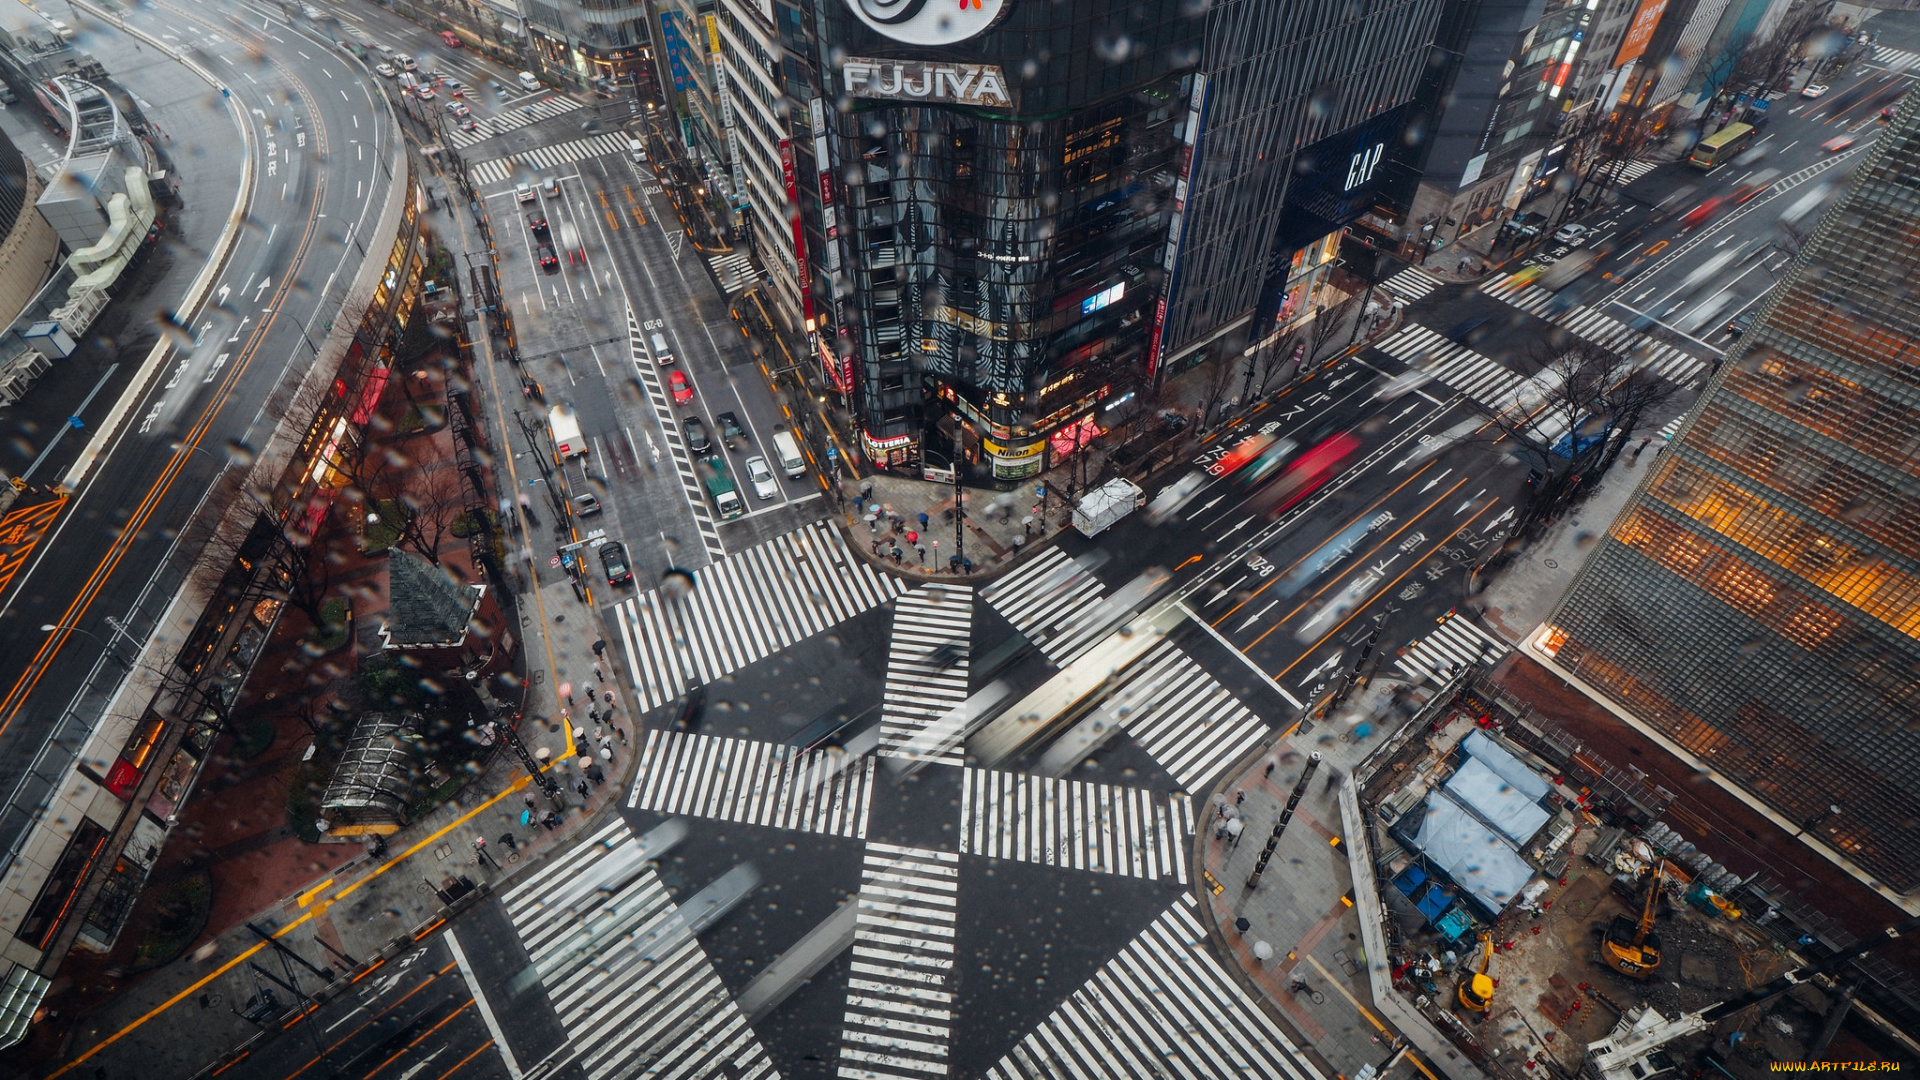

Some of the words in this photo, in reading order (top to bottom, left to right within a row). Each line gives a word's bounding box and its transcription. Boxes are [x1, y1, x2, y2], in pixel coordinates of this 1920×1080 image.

[843, 62, 1007, 101] FUJIYA
[294, 116, 306, 147] 上野
[264, 124, 277, 177] 北池袋
[782, 147, 794, 188] カラオケ
[1344, 142, 1384, 192] GAP
[643, 318, 663, 331] 8-20
[867, 436, 911, 448] LOTTERIA
[997, 449, 1029, 457] Nikon
[1192, 454, 1225, 476] 17-19
[1247, 555, 1275, 577] 8-20
